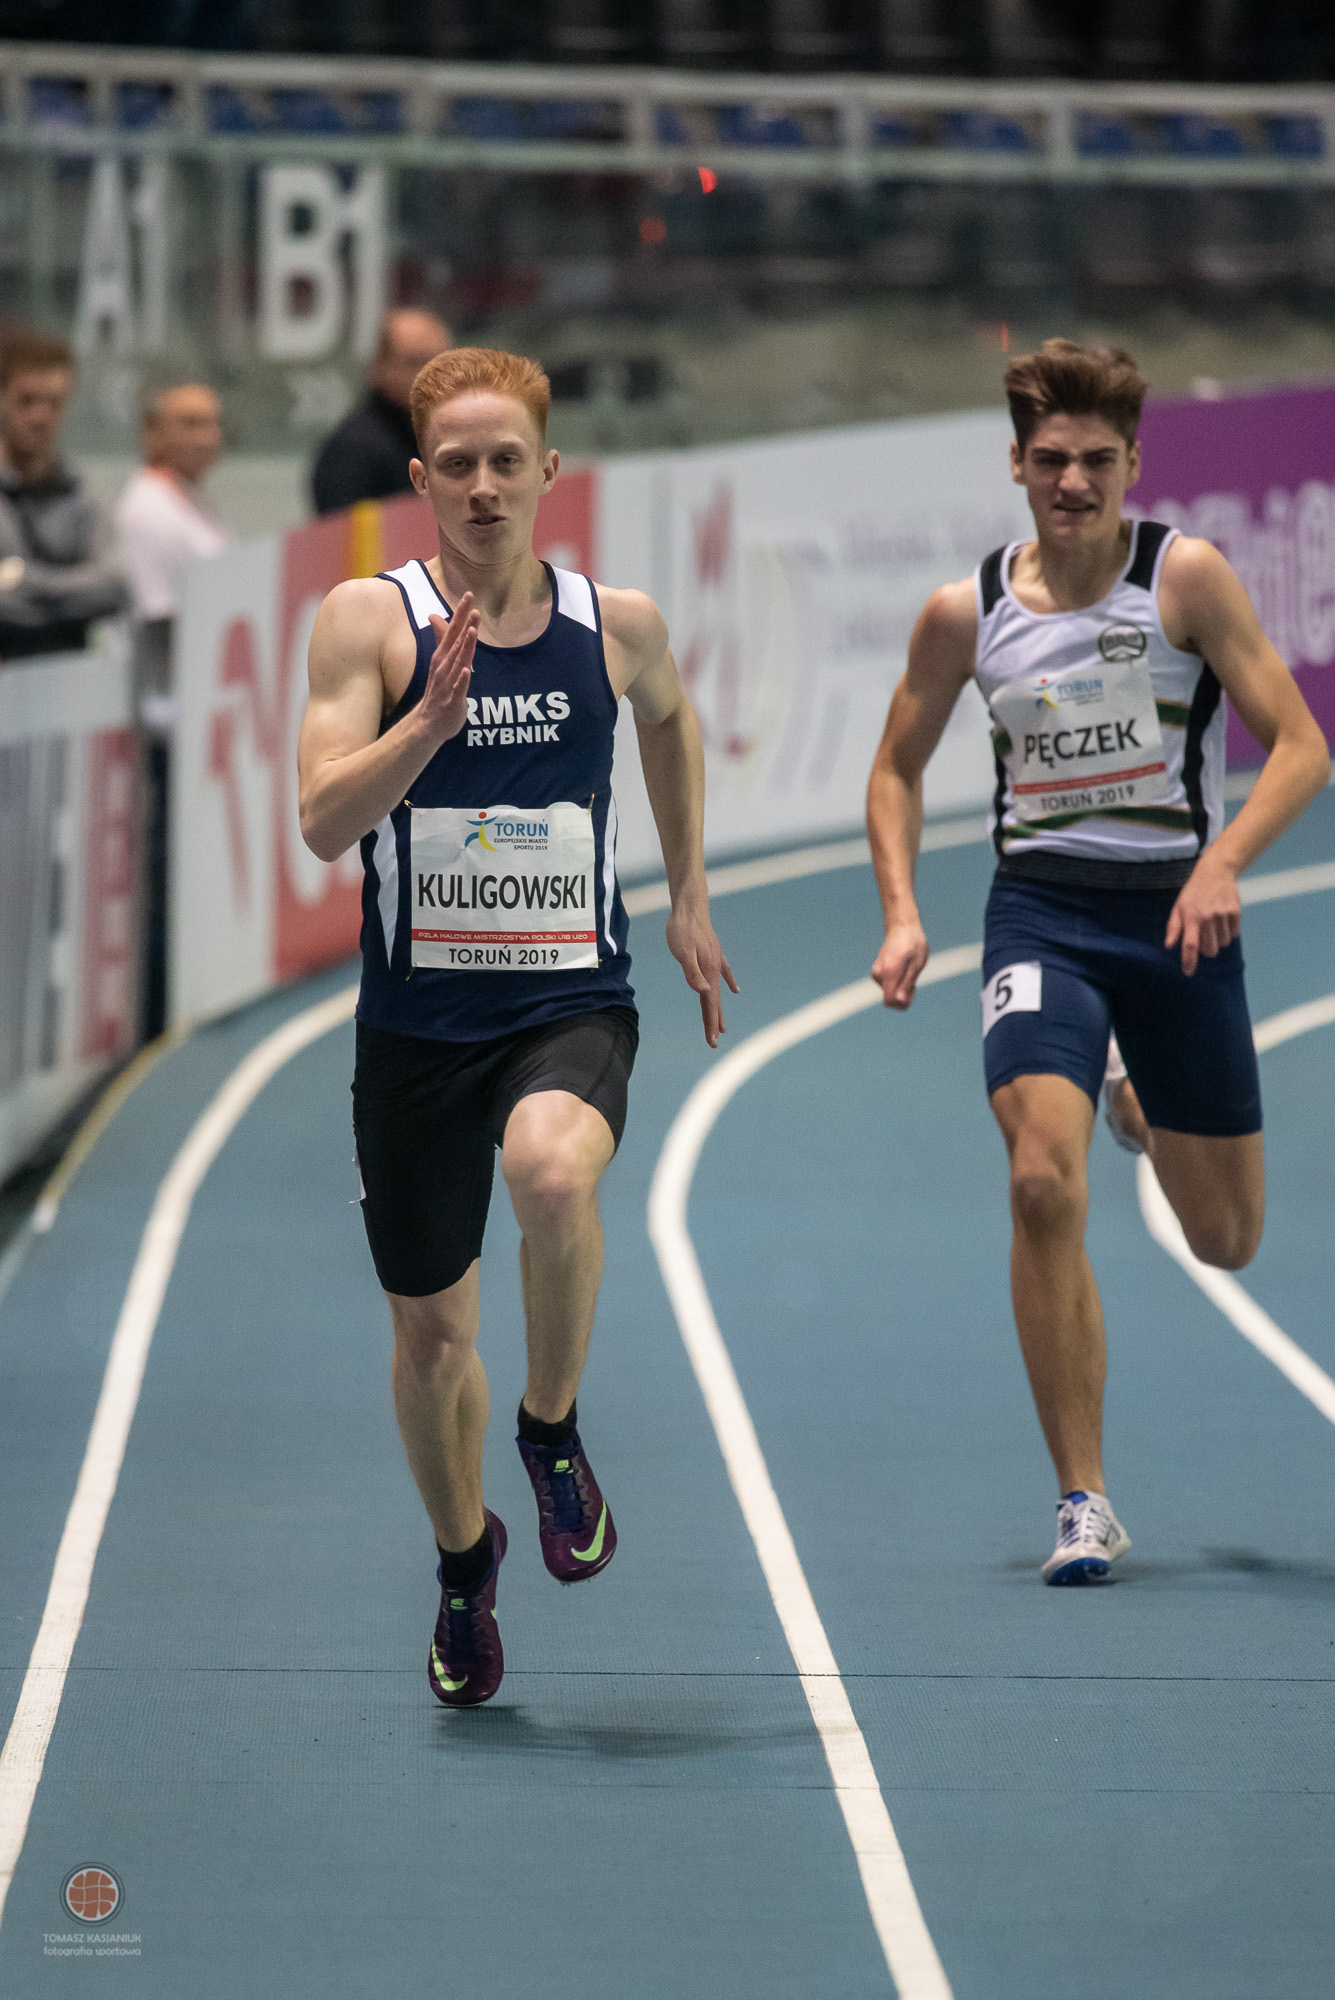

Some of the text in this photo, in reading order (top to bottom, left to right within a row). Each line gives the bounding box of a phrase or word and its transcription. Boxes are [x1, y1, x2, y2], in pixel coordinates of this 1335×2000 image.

[259, 163, 388, 357] B1
[466, 691, 571, 725] RMKS
[467, 723, 560, 747] RYBNIK
[1023, 718, 1142, 769] PĘCZEK
[1097, 783, 1135, 804] 2019
[494, 818, 549, 837] TORUŃ
[418, 873, 586, 910] KULIGOWSKI
[449, 945, 559, 965] TORUŃ 2019
[994, 972, 1012, 1011] 5
